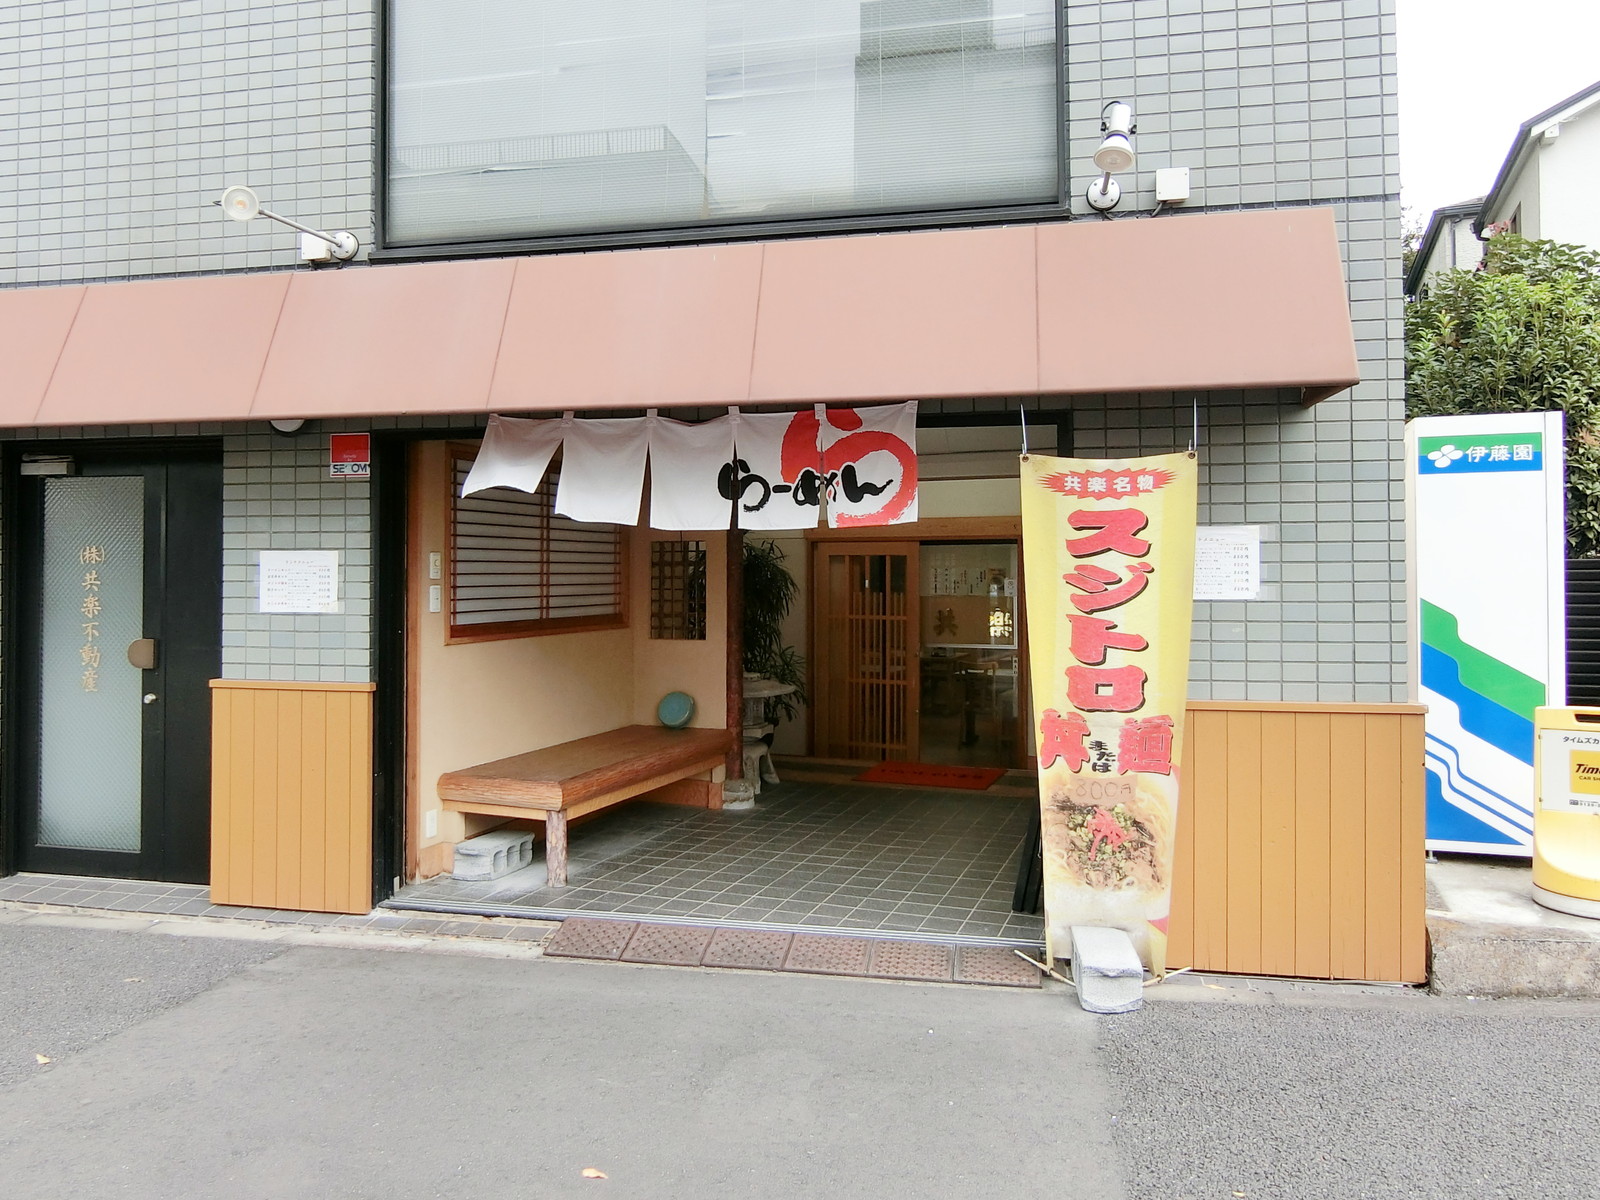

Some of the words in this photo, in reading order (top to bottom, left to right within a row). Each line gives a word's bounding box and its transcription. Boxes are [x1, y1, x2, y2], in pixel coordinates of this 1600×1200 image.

[1465, 444, 1533, 463] 伊藤園
[332, 463, 368, 473] SEOM
[717, 458, 894, 513] らーめん
[1063, 475, 1155, 493] 共楽名物
[1062, 507, 1154, 713] スジトロ
[1040, 708, 1091, 774] 丼
[1088, 740, 1116, 774] または
[1117, 714, 1174, 776] 麺
[1563, 736, 1600, 745] タイムズカ
[1575, 763, 1600, 775] Tim
